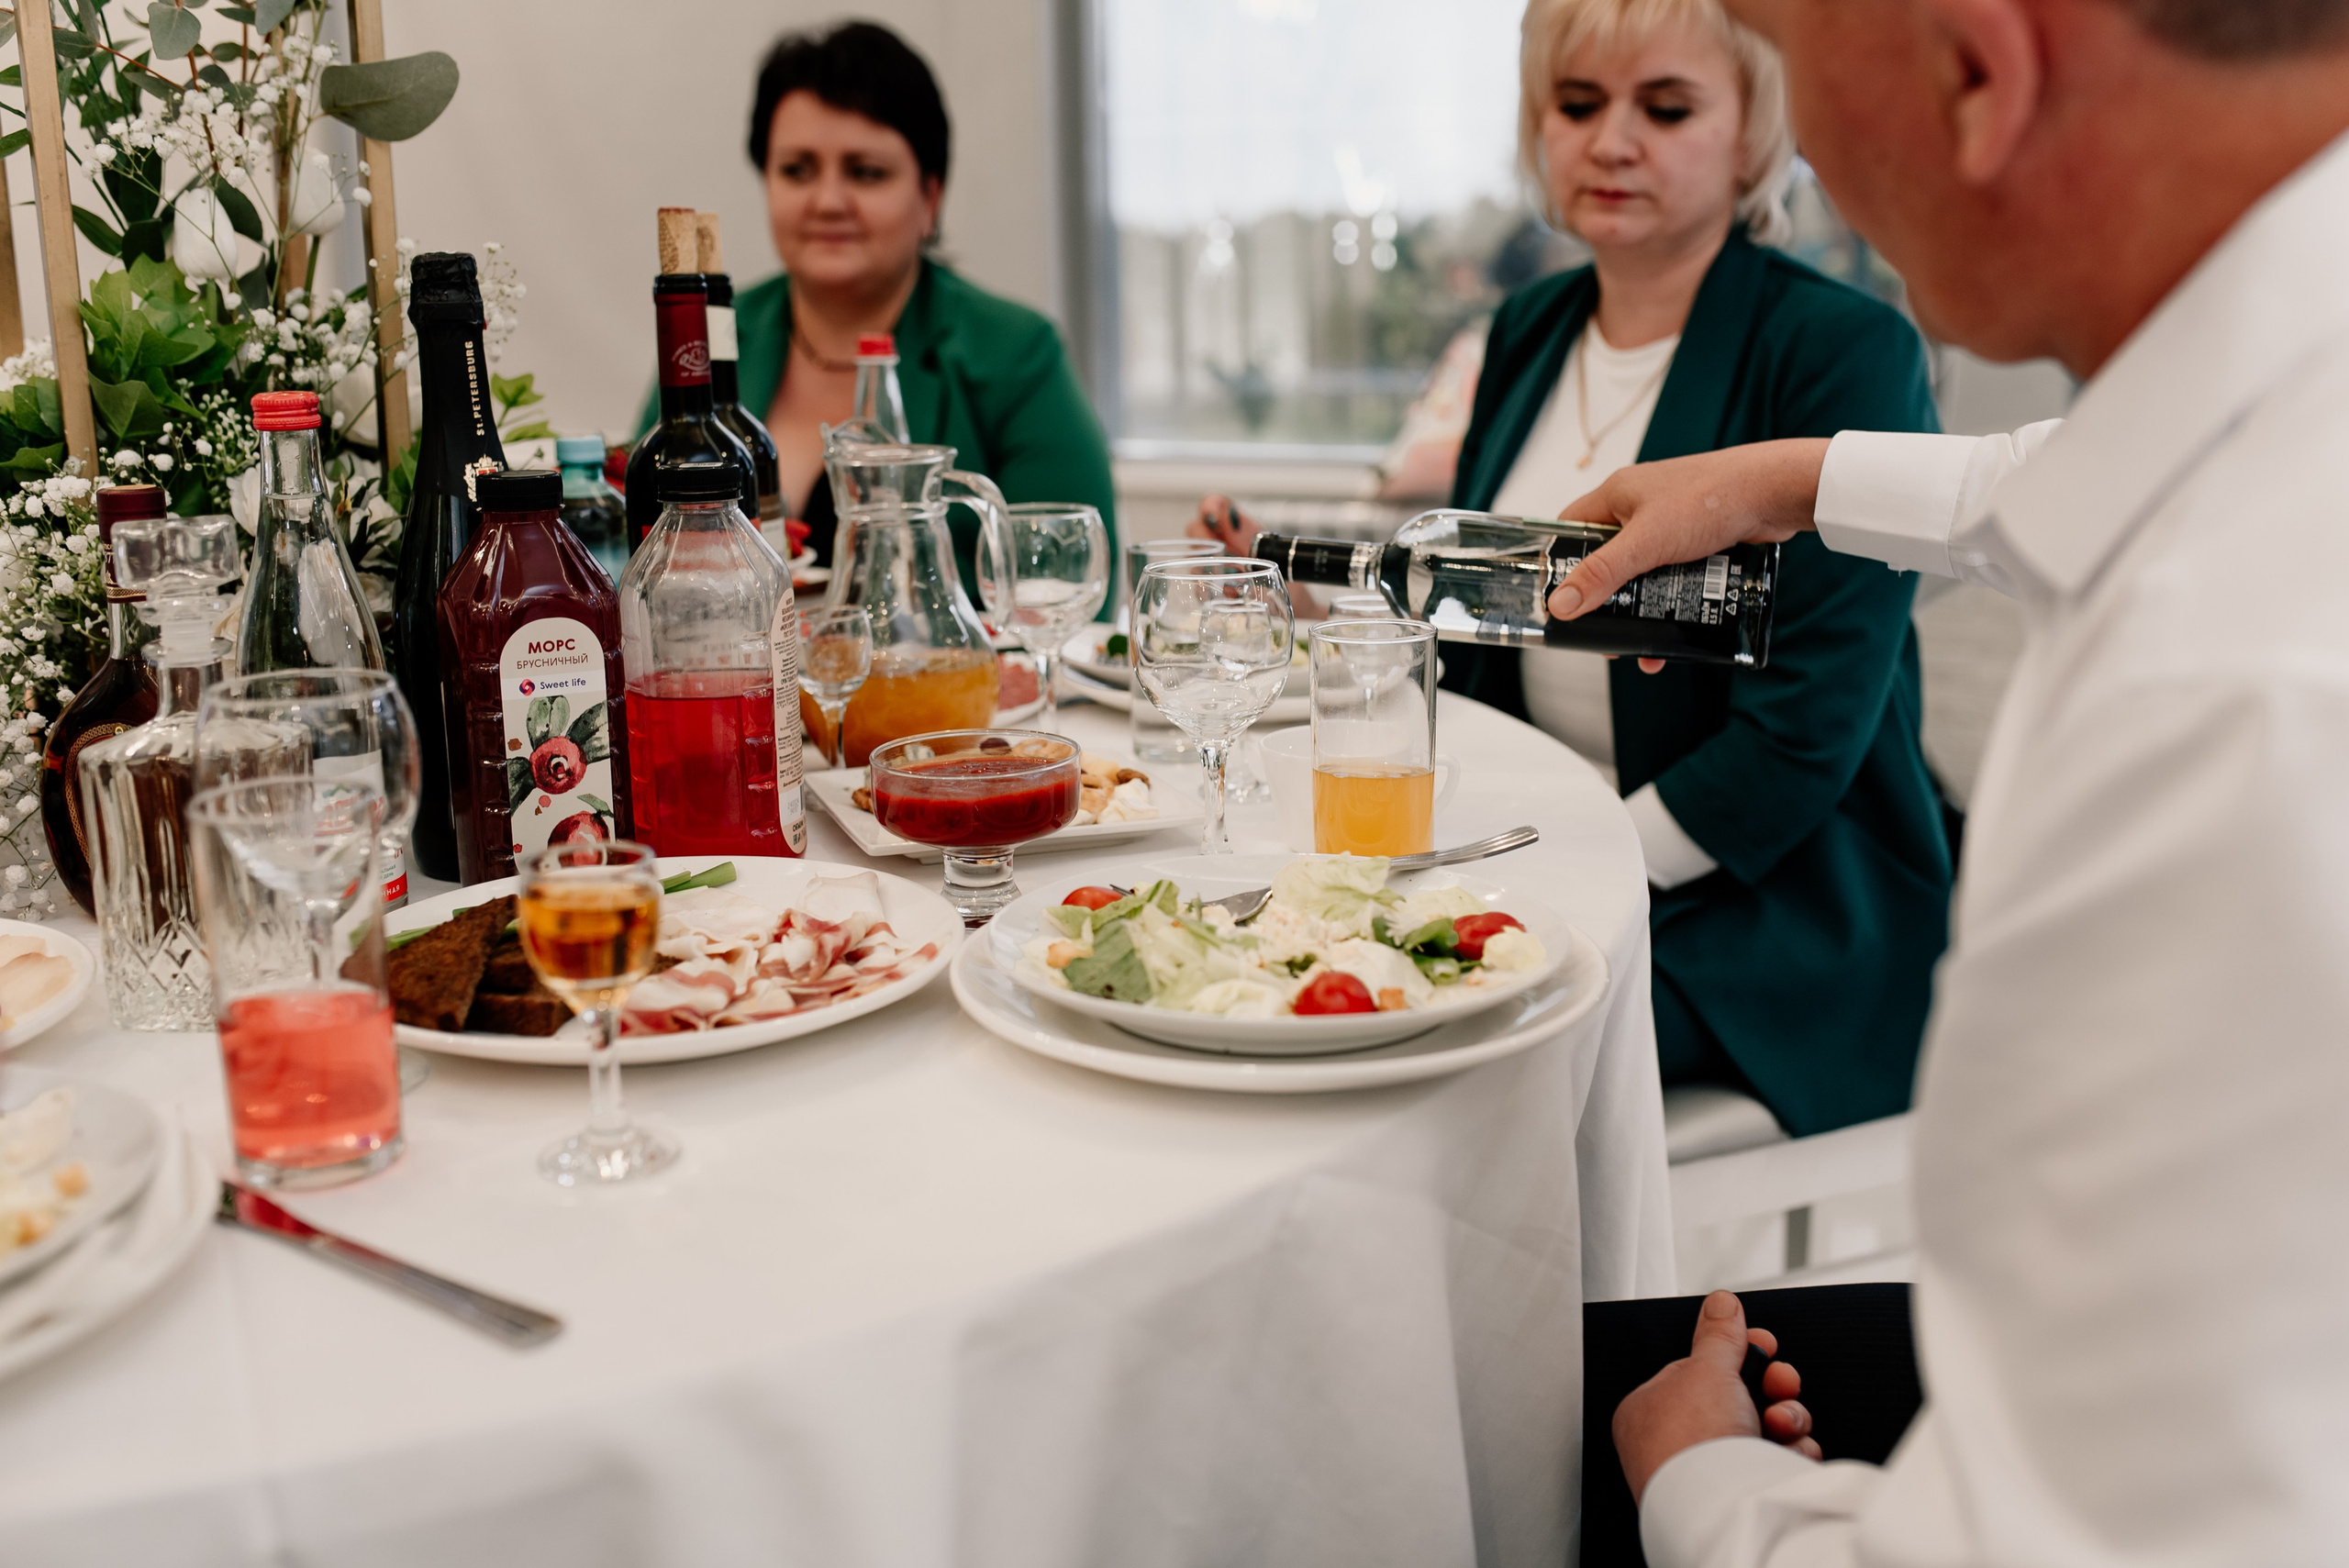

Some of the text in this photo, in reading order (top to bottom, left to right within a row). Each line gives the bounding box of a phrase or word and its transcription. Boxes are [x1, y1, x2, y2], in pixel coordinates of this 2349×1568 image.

[528, 639, 575, 654] МОРС
[517, 652, 588, 670] БРУСНИЧНЫЙ
[540, 678, 586, 690] Sweet life
